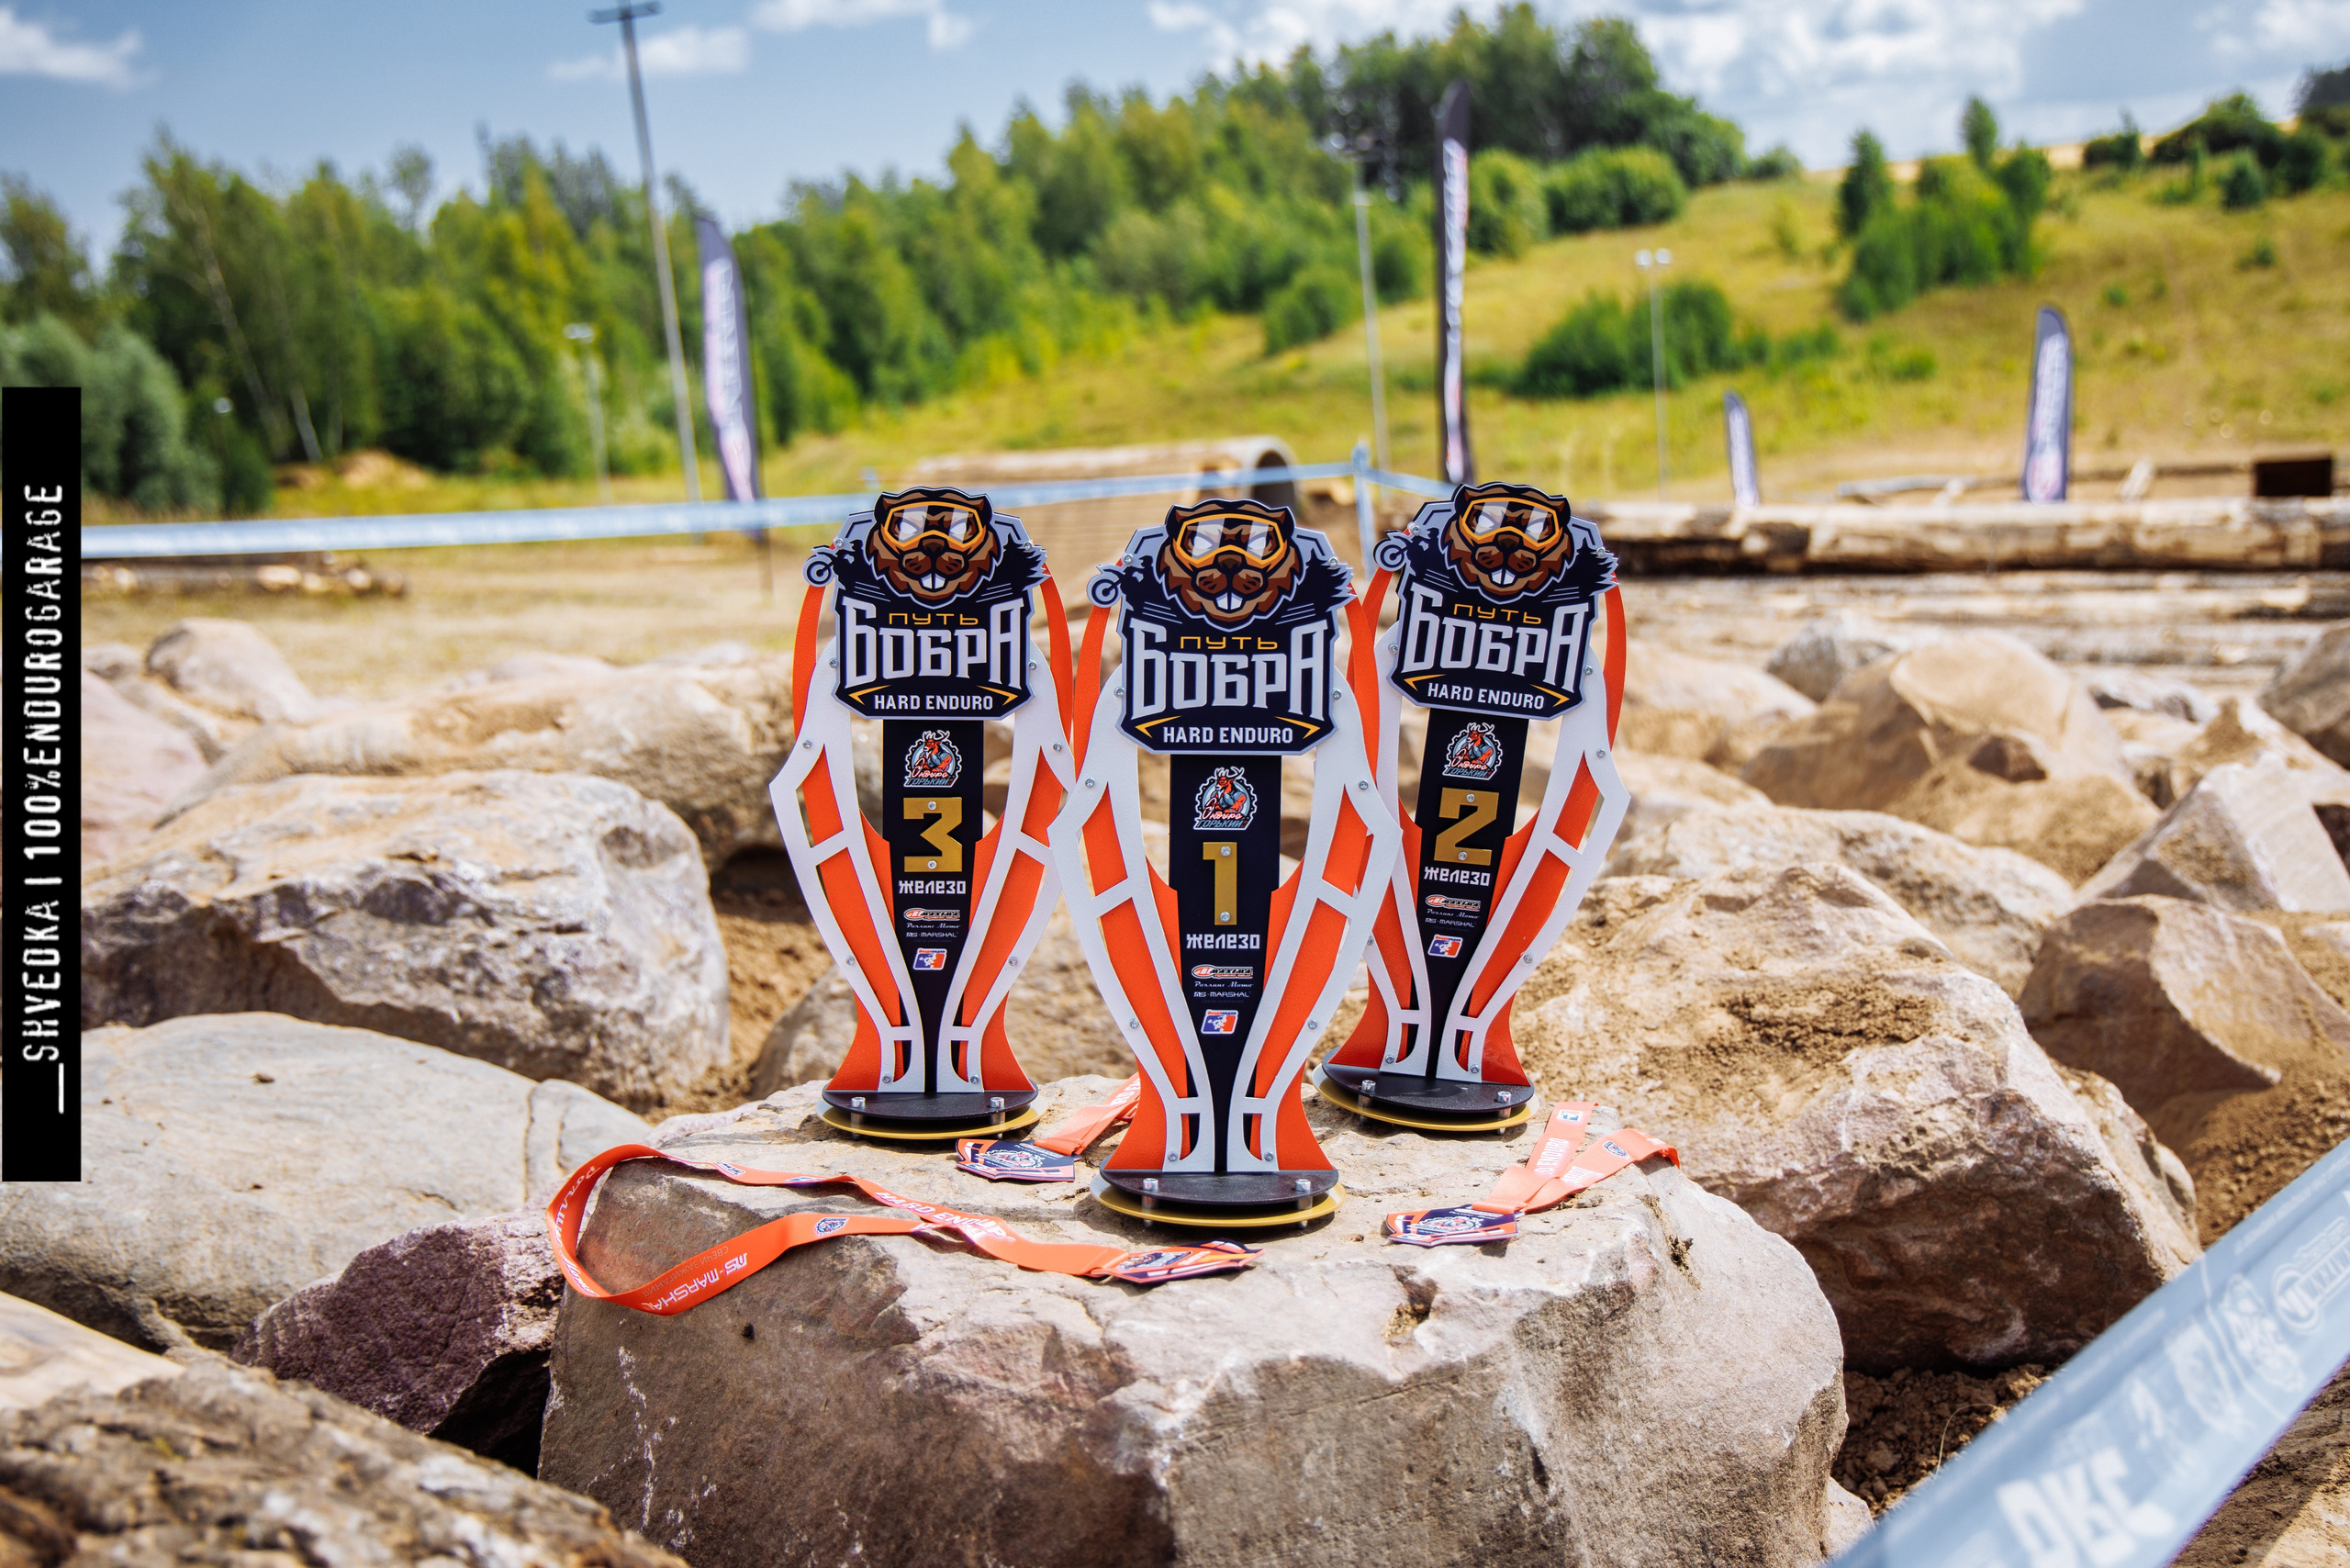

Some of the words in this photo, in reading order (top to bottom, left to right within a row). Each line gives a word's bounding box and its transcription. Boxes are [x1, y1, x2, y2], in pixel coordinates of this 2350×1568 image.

[889, 613, 979, 625] ПУТЬ
[1453, 603, 1542, 624] ПУТЬ
[842, 597, 1024, 689] БОБРА
[1181, 636, 1278, 650] ПУТЬ
[1402, 581, 1589, 693] БОБРА
[1129, 618, 1328, 721] БОБРА
[874, 695, 921, 711] HARD
[925, 695, 993, 711] ENDURO
[1427, 682, 1472, 701] HARD
[1477, 689, 1544, 710] ENDURO
[1163, 727, 1214, 744] HARD
[1219, 727, 1292, 744] ENDURO
[903, 797, 962, 872] 3
[1434, 787, 1499, 866] 2
[1203, 842, 1237, 925] 1
[875, 1192, 935, 1215] HARD
